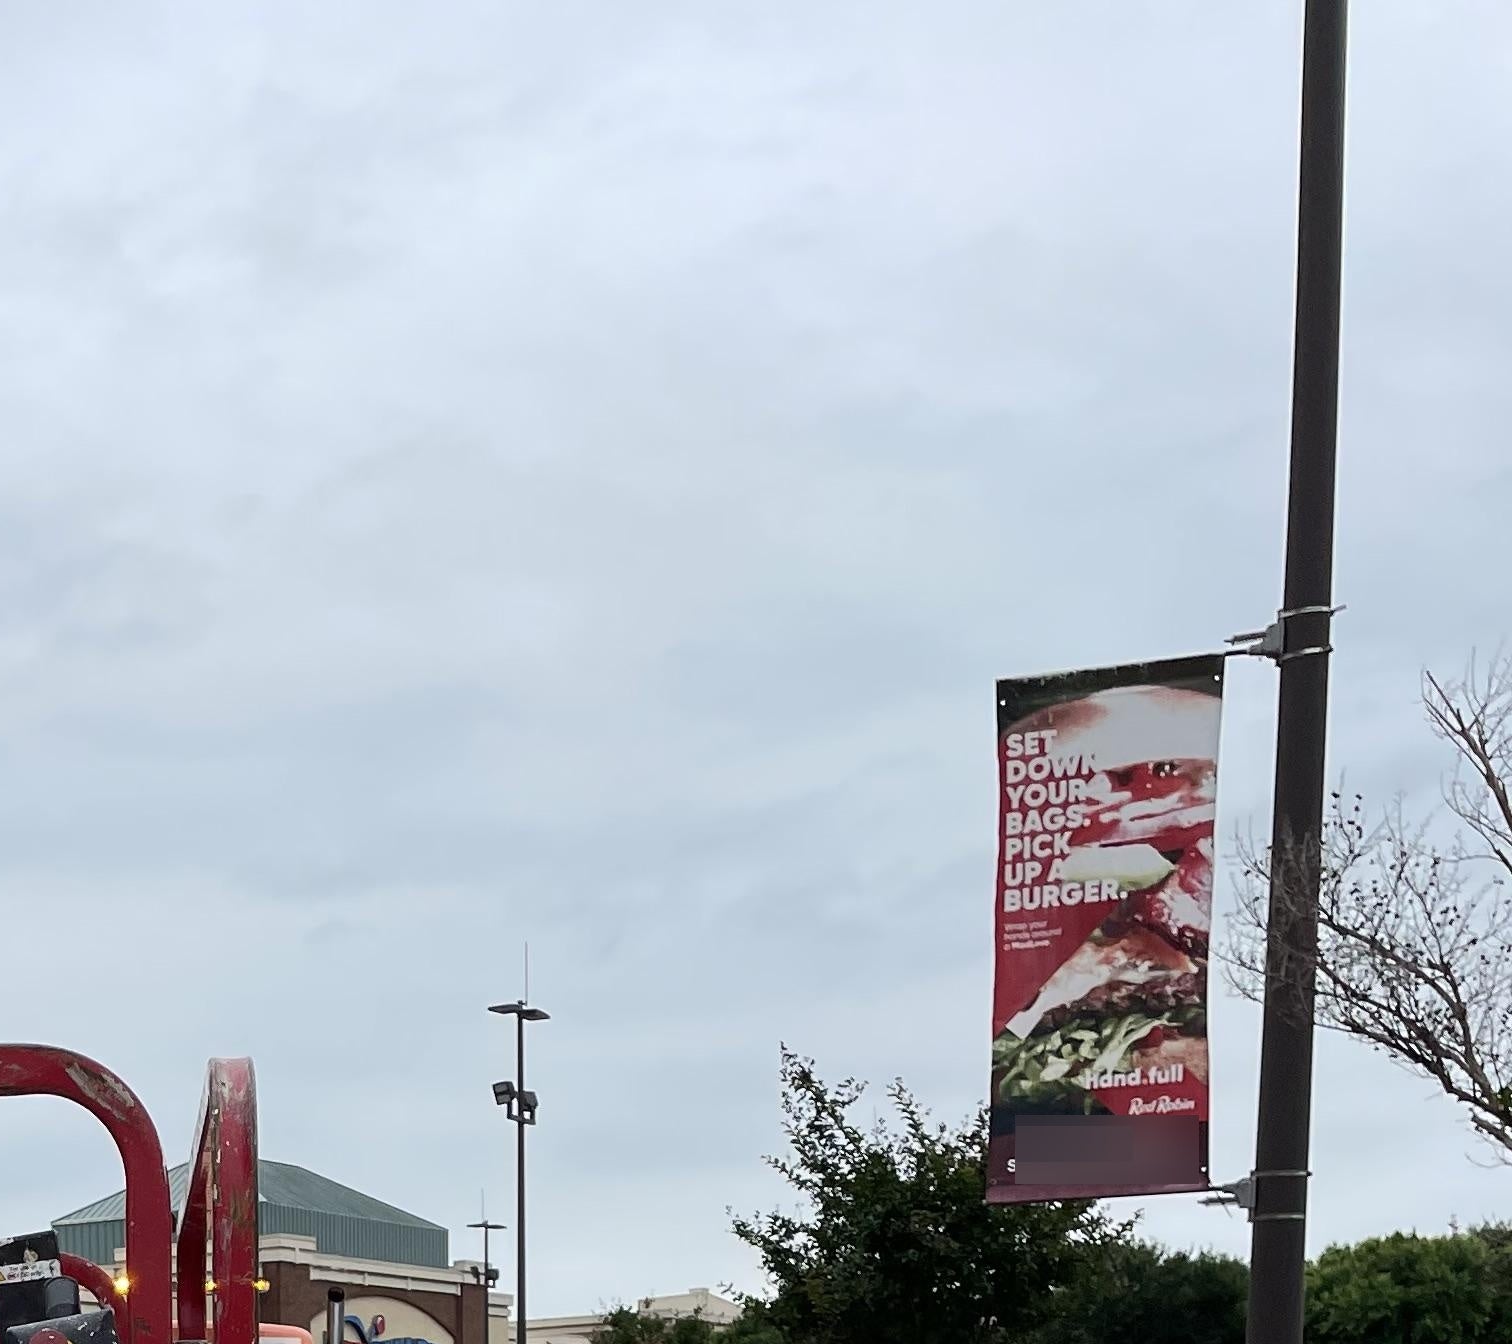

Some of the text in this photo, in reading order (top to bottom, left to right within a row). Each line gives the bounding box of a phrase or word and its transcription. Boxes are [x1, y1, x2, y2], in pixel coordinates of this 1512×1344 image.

[1006, 729, 1057, 757] SET
[1006, 778, 1088, 809] YOUR
[1005, 804, 1091, 836] BAGS.
[1005, 831, 1073, 861] PICK
[1004, 858, 1067, 886] UP A
[1003, 879, 1128, 912] BURGER.
